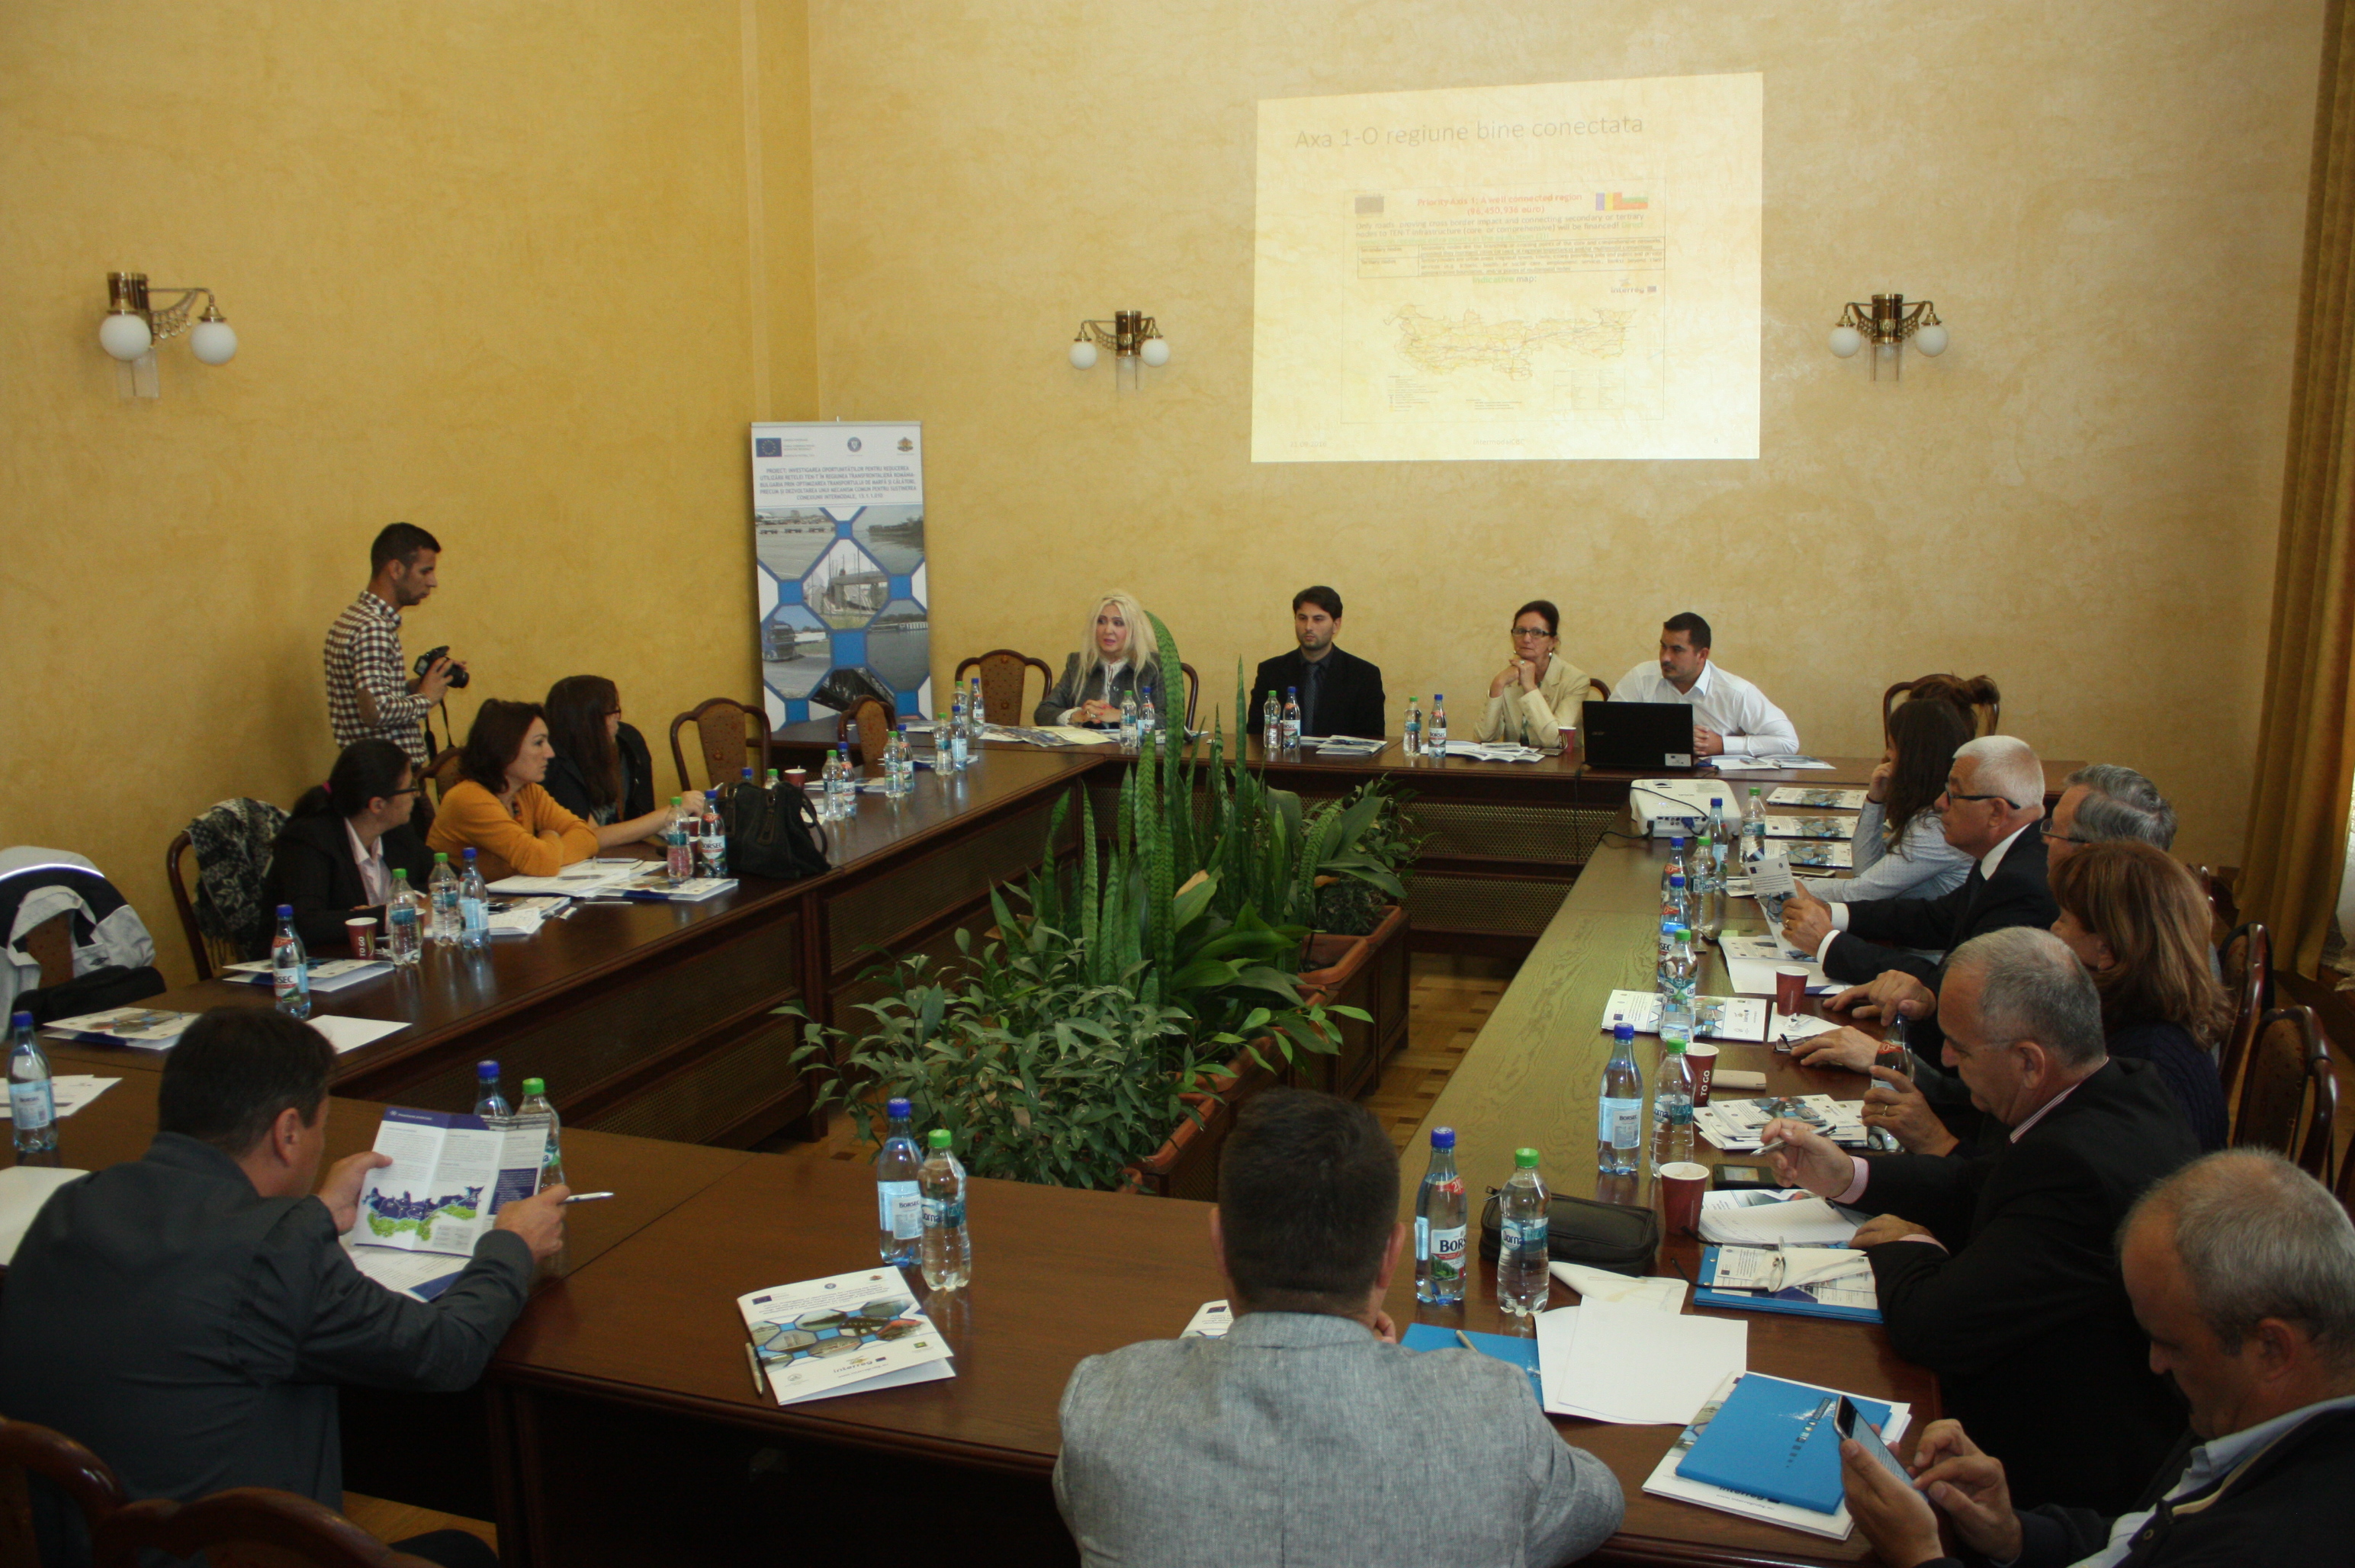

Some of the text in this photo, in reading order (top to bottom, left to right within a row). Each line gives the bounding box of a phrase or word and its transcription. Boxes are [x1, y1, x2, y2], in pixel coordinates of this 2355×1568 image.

[1295, 116, 1643, 148] Axa 1-O regiune bine conectata
[1417, 198, 1447, 207] Priority
[1451, 198, 1468, 206] Axis
[1489, 195, 1507, 204] well
[1508, 194, 1553, 203] connected
[1555, 193, 1582, 203] region
[1356, 222, 1373, 230] Only
[1450, 218, 1476, 227] border
[1478, 218, 1502, 227] impact
[1521, 216, 1562, 224] connecting
[1566, 214, 1603, 223] secondary
[1515, 275, 1537, 284] map:
[358, 936, 366, 957] TO GO
[1700, 1069, 1710, 1097] TO GO
[1618, 1113, 1638, 1122] BORSEC
[1503, 1229, 1525, 1245] Dorna
